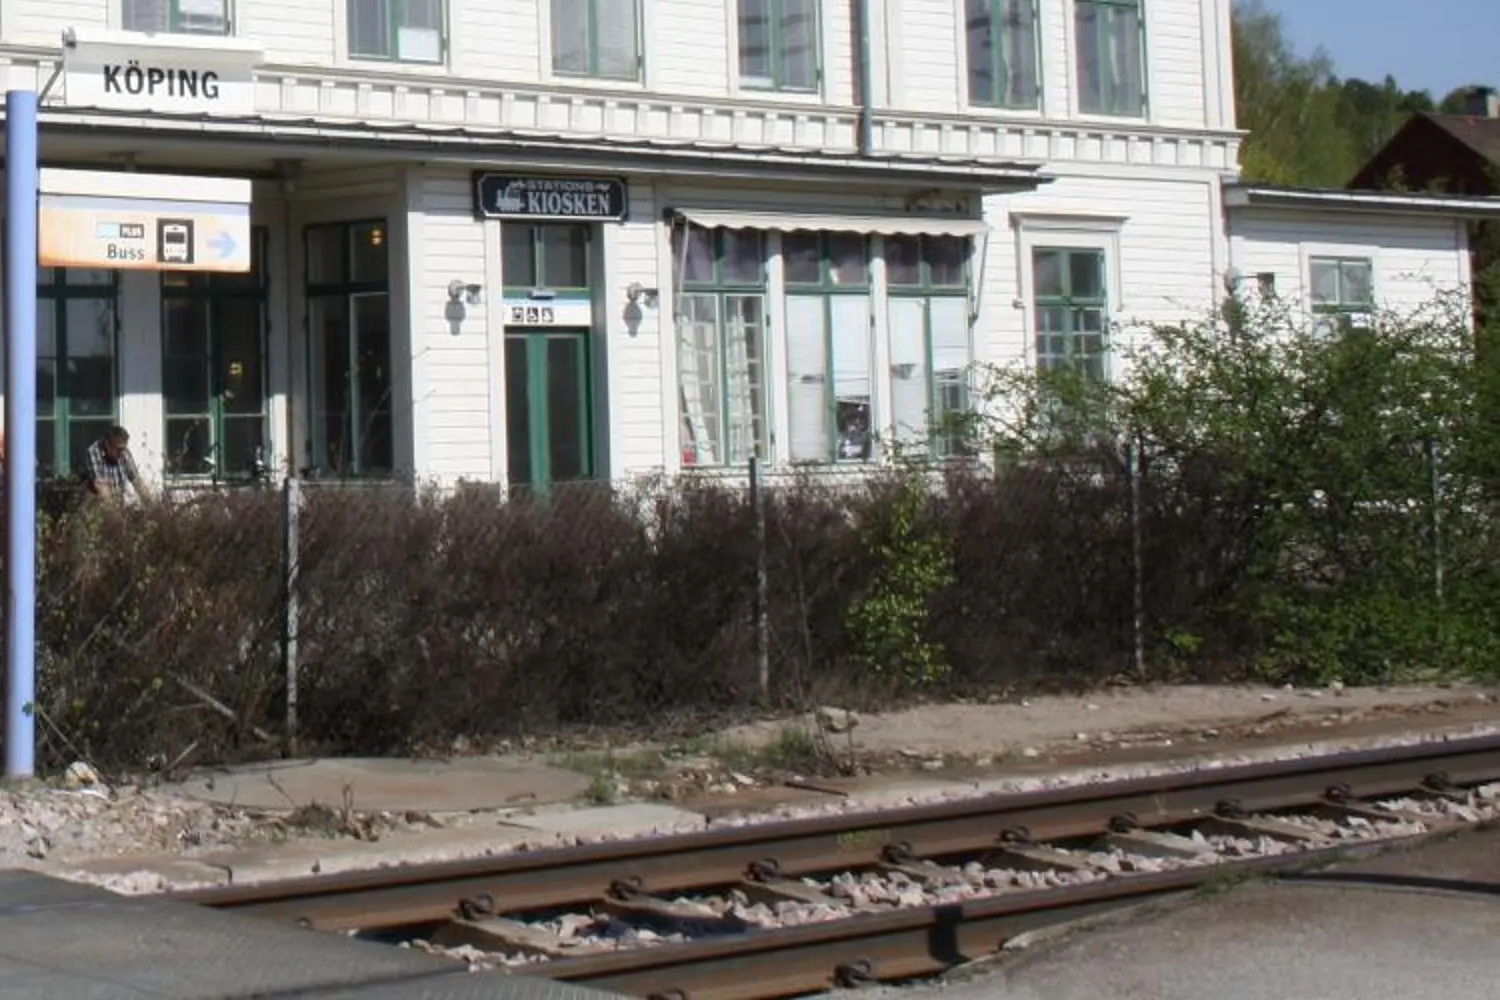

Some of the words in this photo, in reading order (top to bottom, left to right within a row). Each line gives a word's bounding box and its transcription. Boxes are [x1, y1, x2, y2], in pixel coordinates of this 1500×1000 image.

[104, 59, 219, 98] KÖPING
[527, 180, 594, 192] STATIONS
[527, 192, 610, 215] KIOSKEN
[107, 244, 145, 260] Buss
